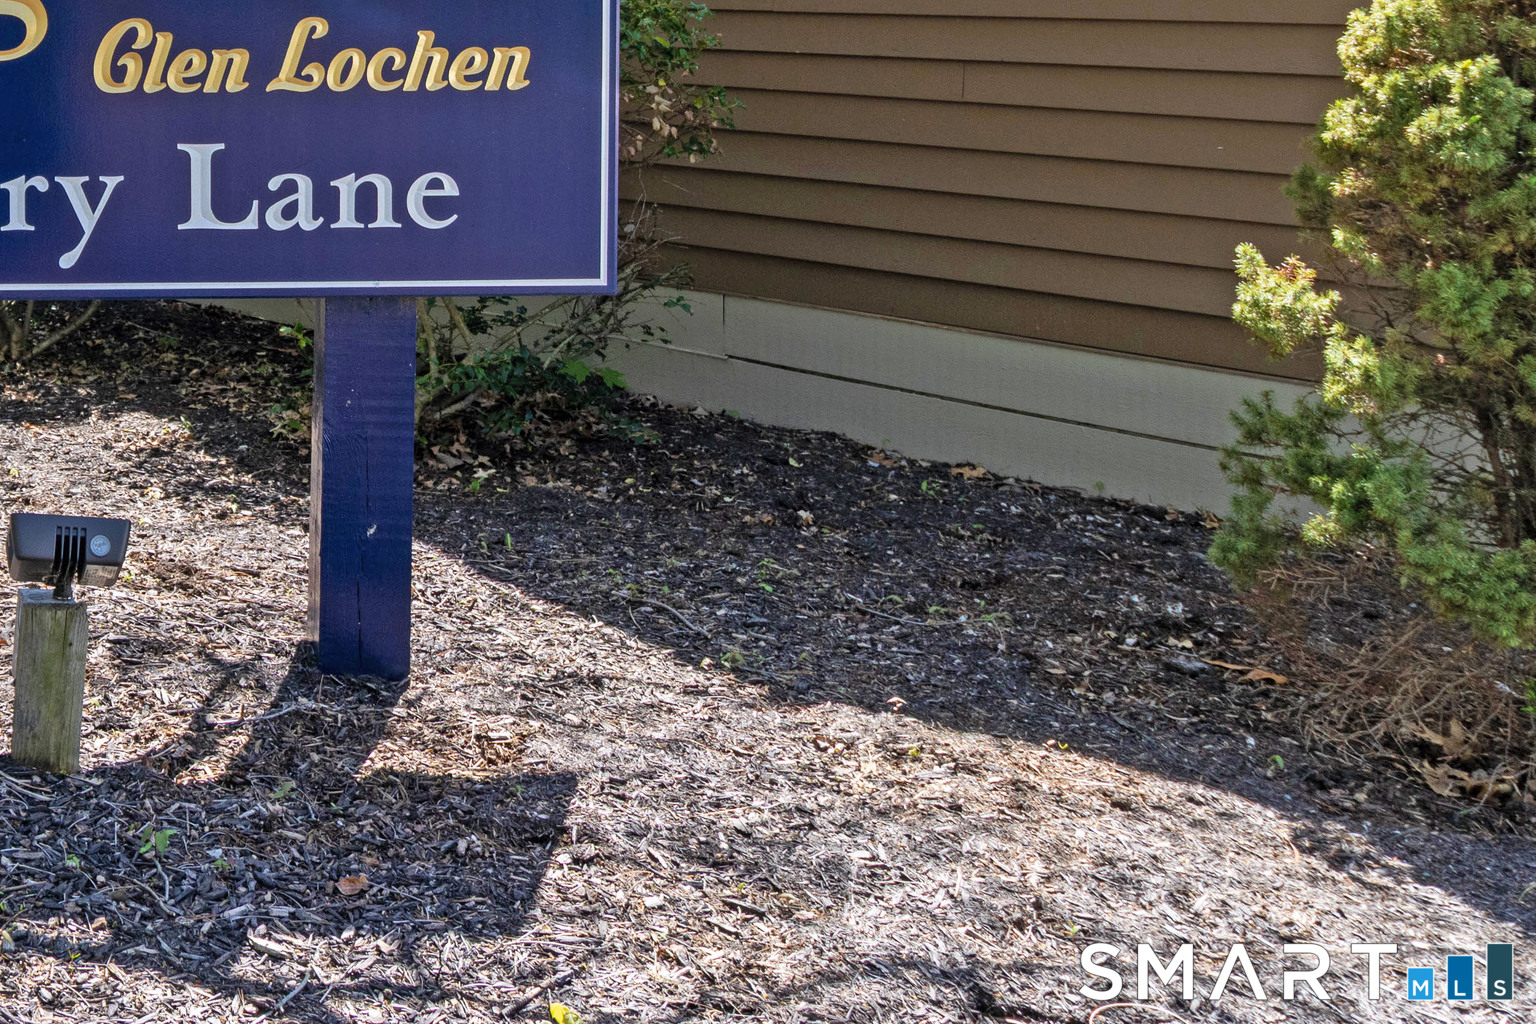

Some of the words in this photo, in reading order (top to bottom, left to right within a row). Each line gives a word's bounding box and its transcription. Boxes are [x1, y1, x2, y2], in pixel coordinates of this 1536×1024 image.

[93, 17, 250, 94] Glen
[266, 16, 531, 93] Lochen
[176, 142, 461, 232] Lane
